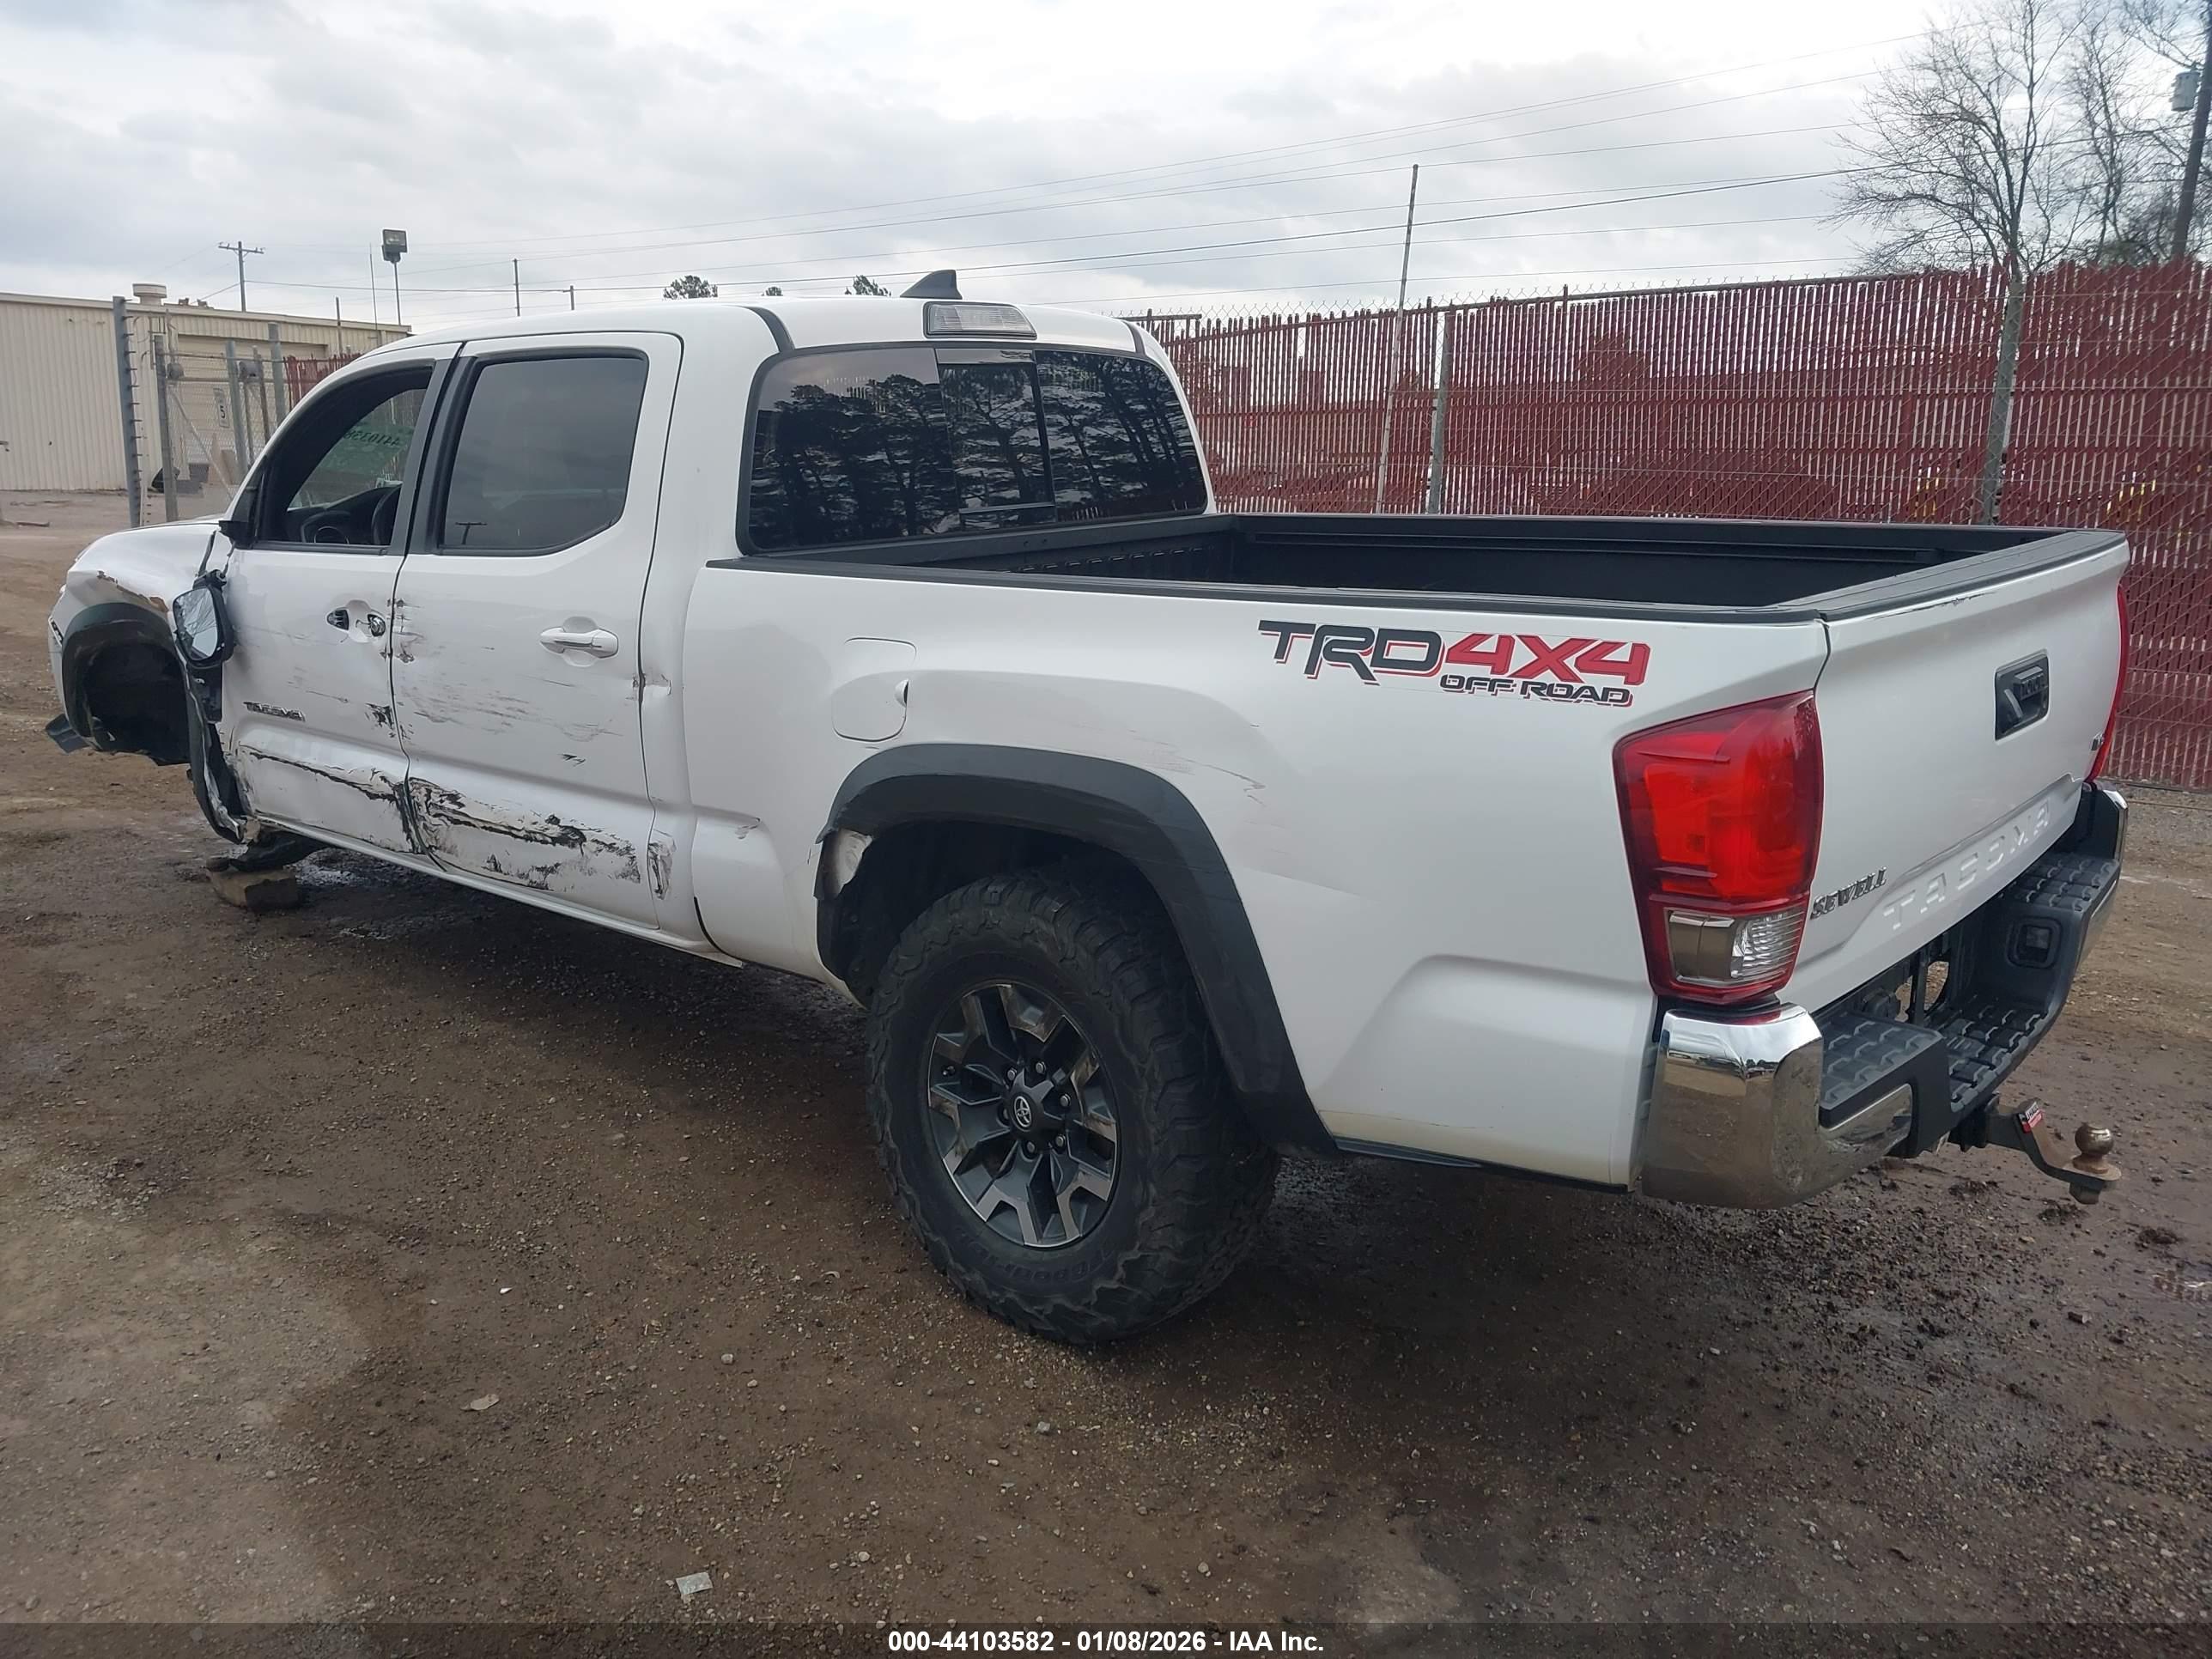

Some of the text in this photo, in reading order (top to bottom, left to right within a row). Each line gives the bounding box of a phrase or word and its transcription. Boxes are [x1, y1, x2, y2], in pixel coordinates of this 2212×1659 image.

[219, 404, 226, 419] 5
[1257, 619, 1445, 686] TRD
[1439, 673, 1633, 708] OFF ROAD
[1809, 866, 1887, 920] SEWELL
